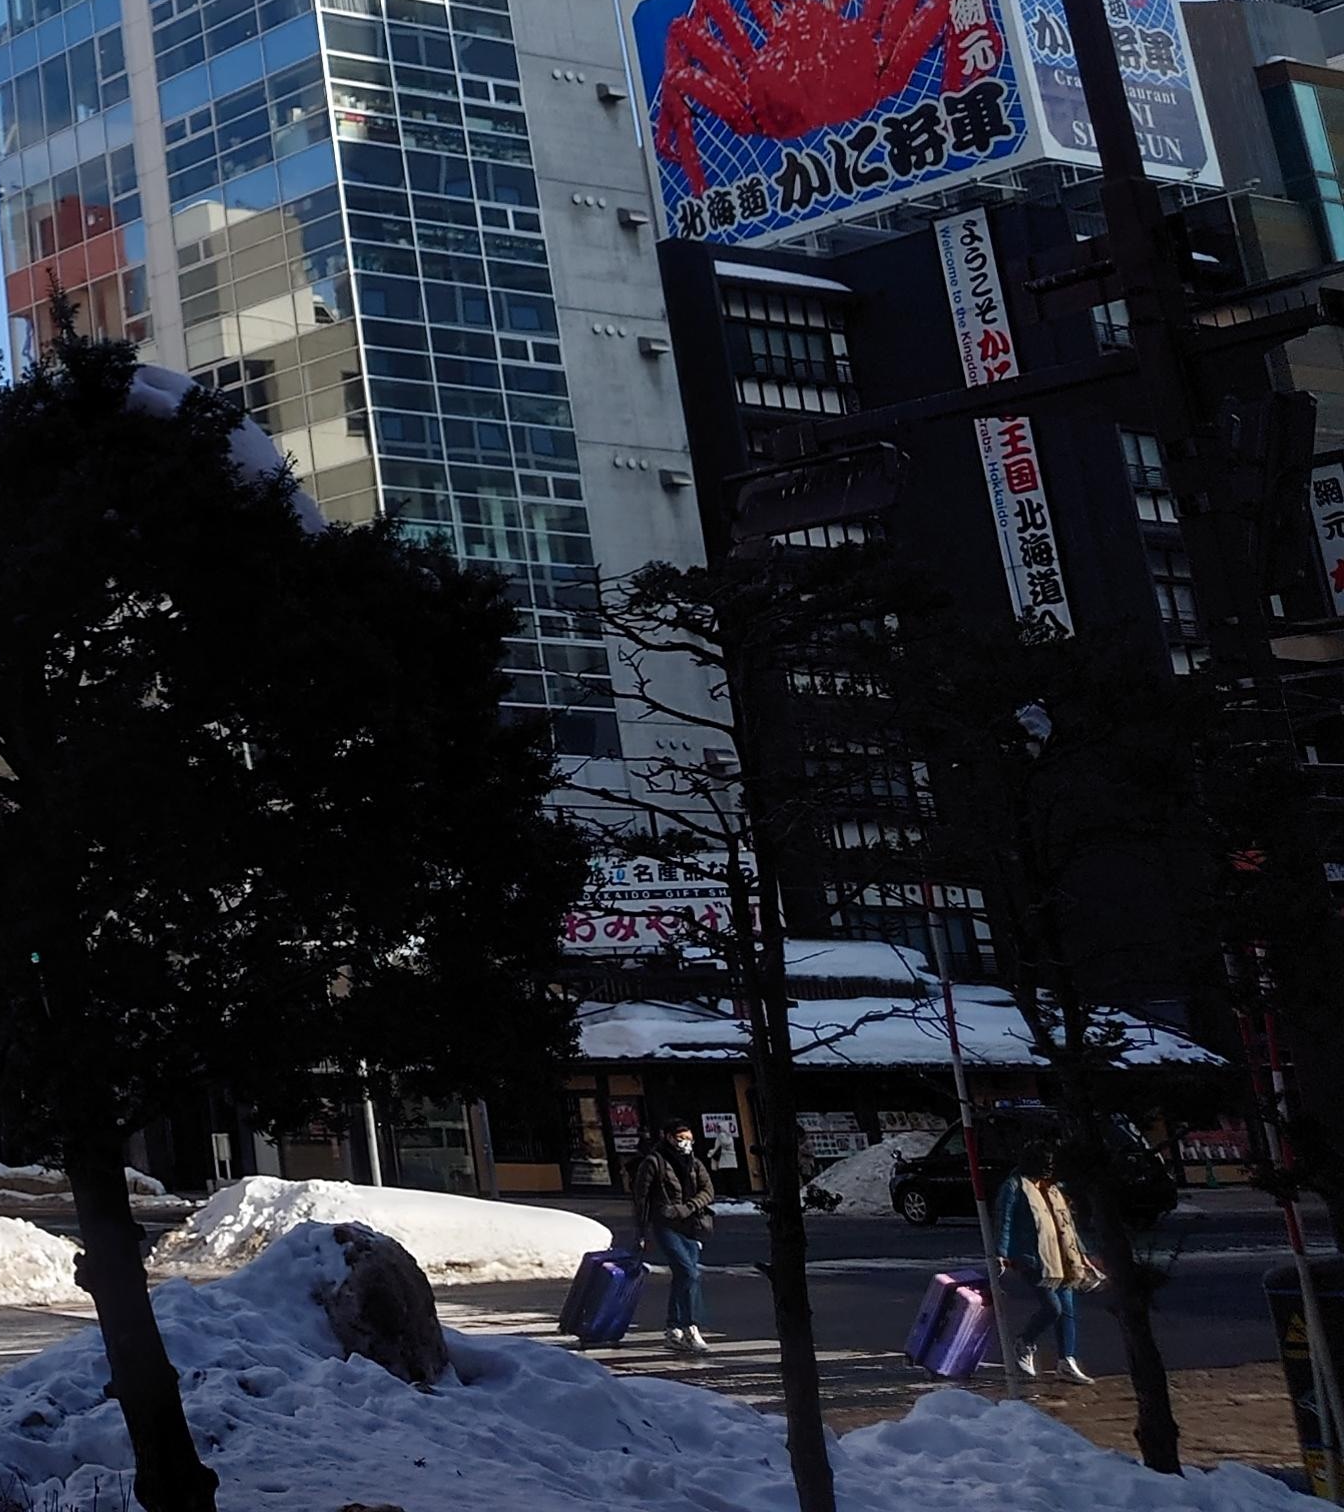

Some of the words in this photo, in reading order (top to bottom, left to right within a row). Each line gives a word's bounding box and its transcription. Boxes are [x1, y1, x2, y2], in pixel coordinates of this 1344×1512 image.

[1054, 68, 1083, 89] Cra
[776, 80, 1013, 212] かに将軍
[940, 226, 958, 287] Welcome
[952, 289, 962, 304] to
[956, 306, 966, 329] the
[988, 461, 1009, 528] Hokkaido
